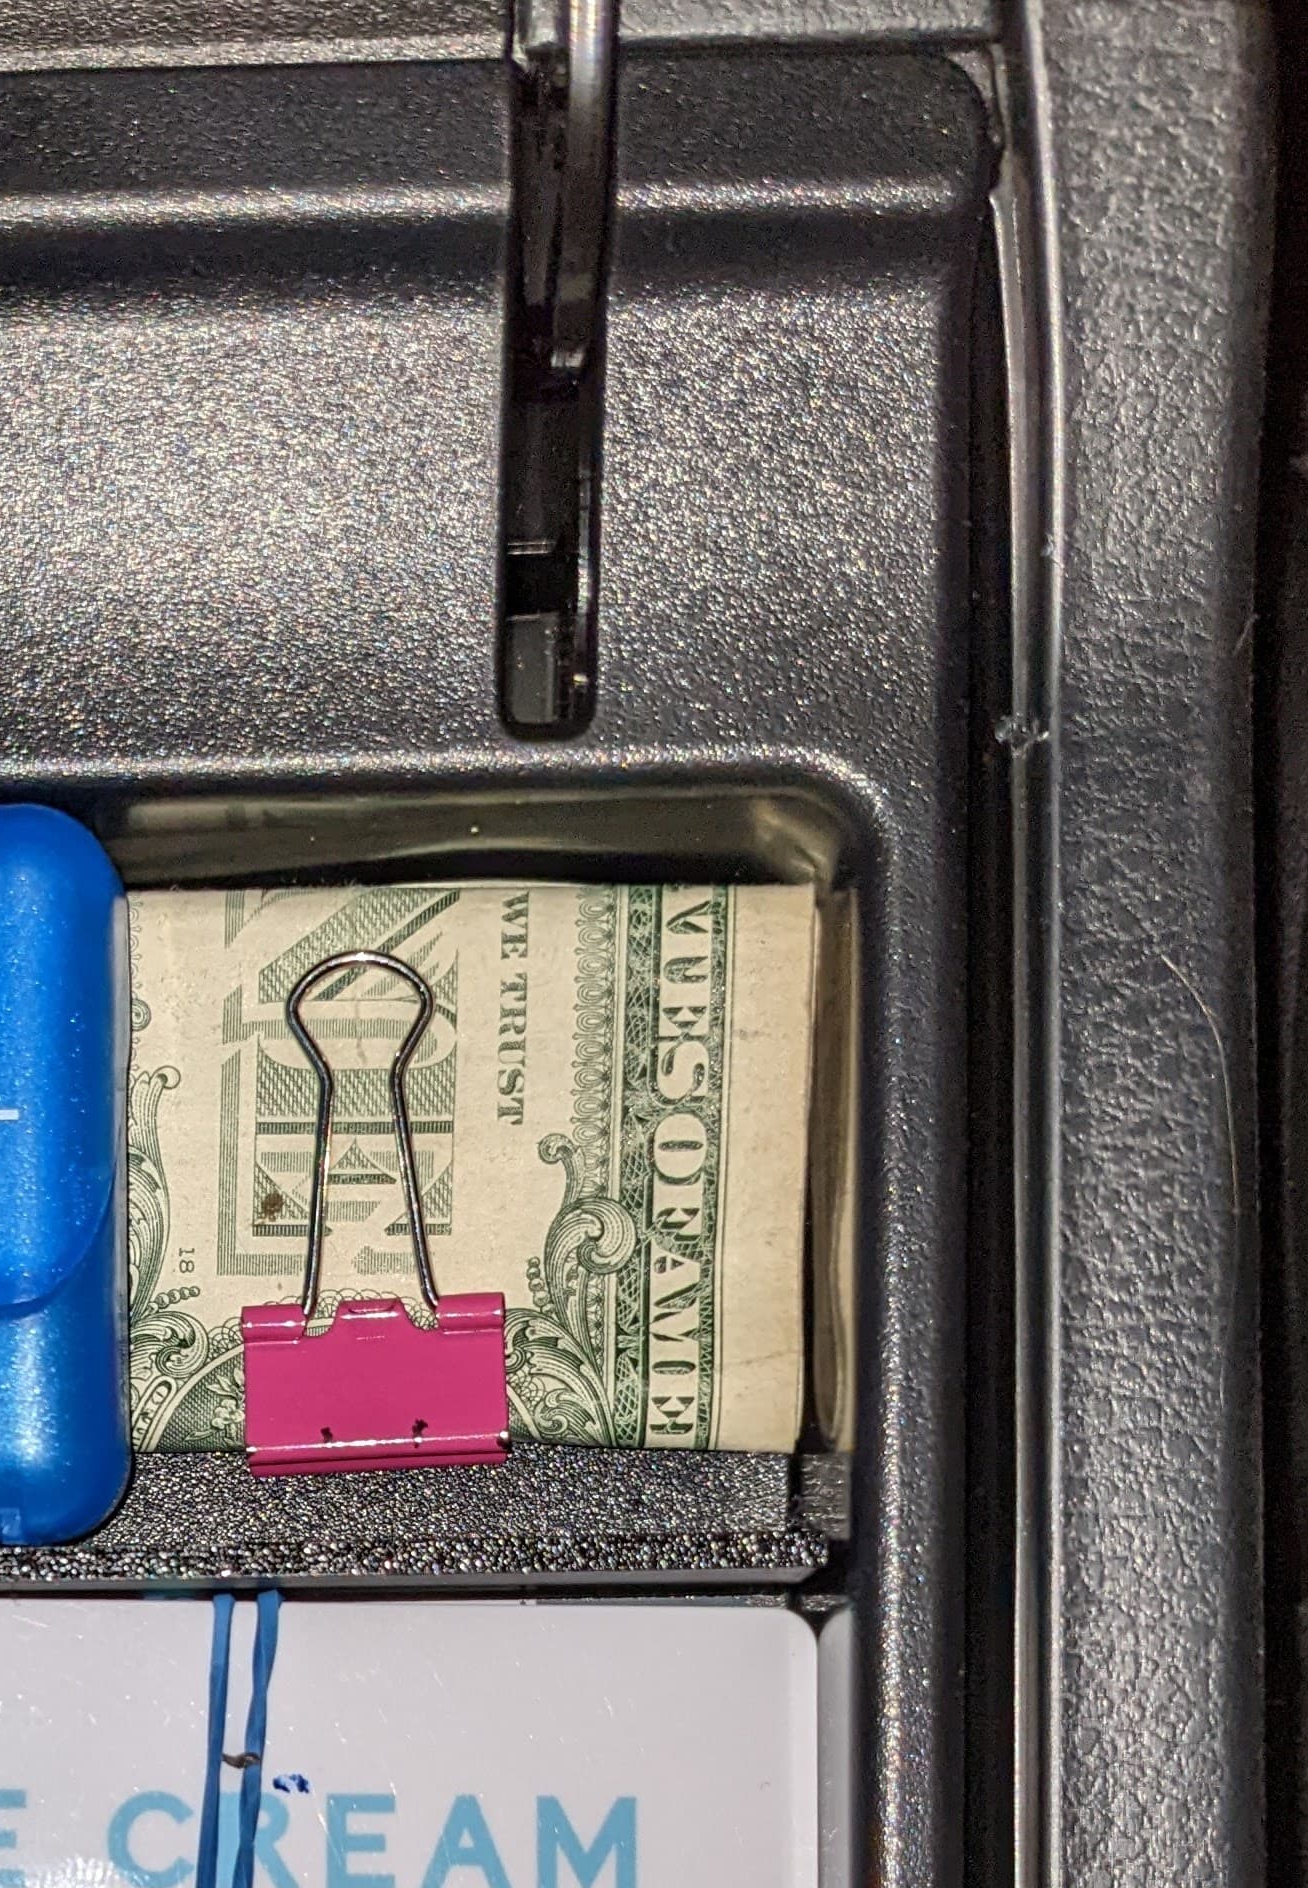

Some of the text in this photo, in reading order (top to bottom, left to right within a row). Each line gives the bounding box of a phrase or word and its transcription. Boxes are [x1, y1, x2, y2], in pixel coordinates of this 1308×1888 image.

[496, 892, 530, 1126] WE TRUST
[177, 1246, 196, 1275] 18
